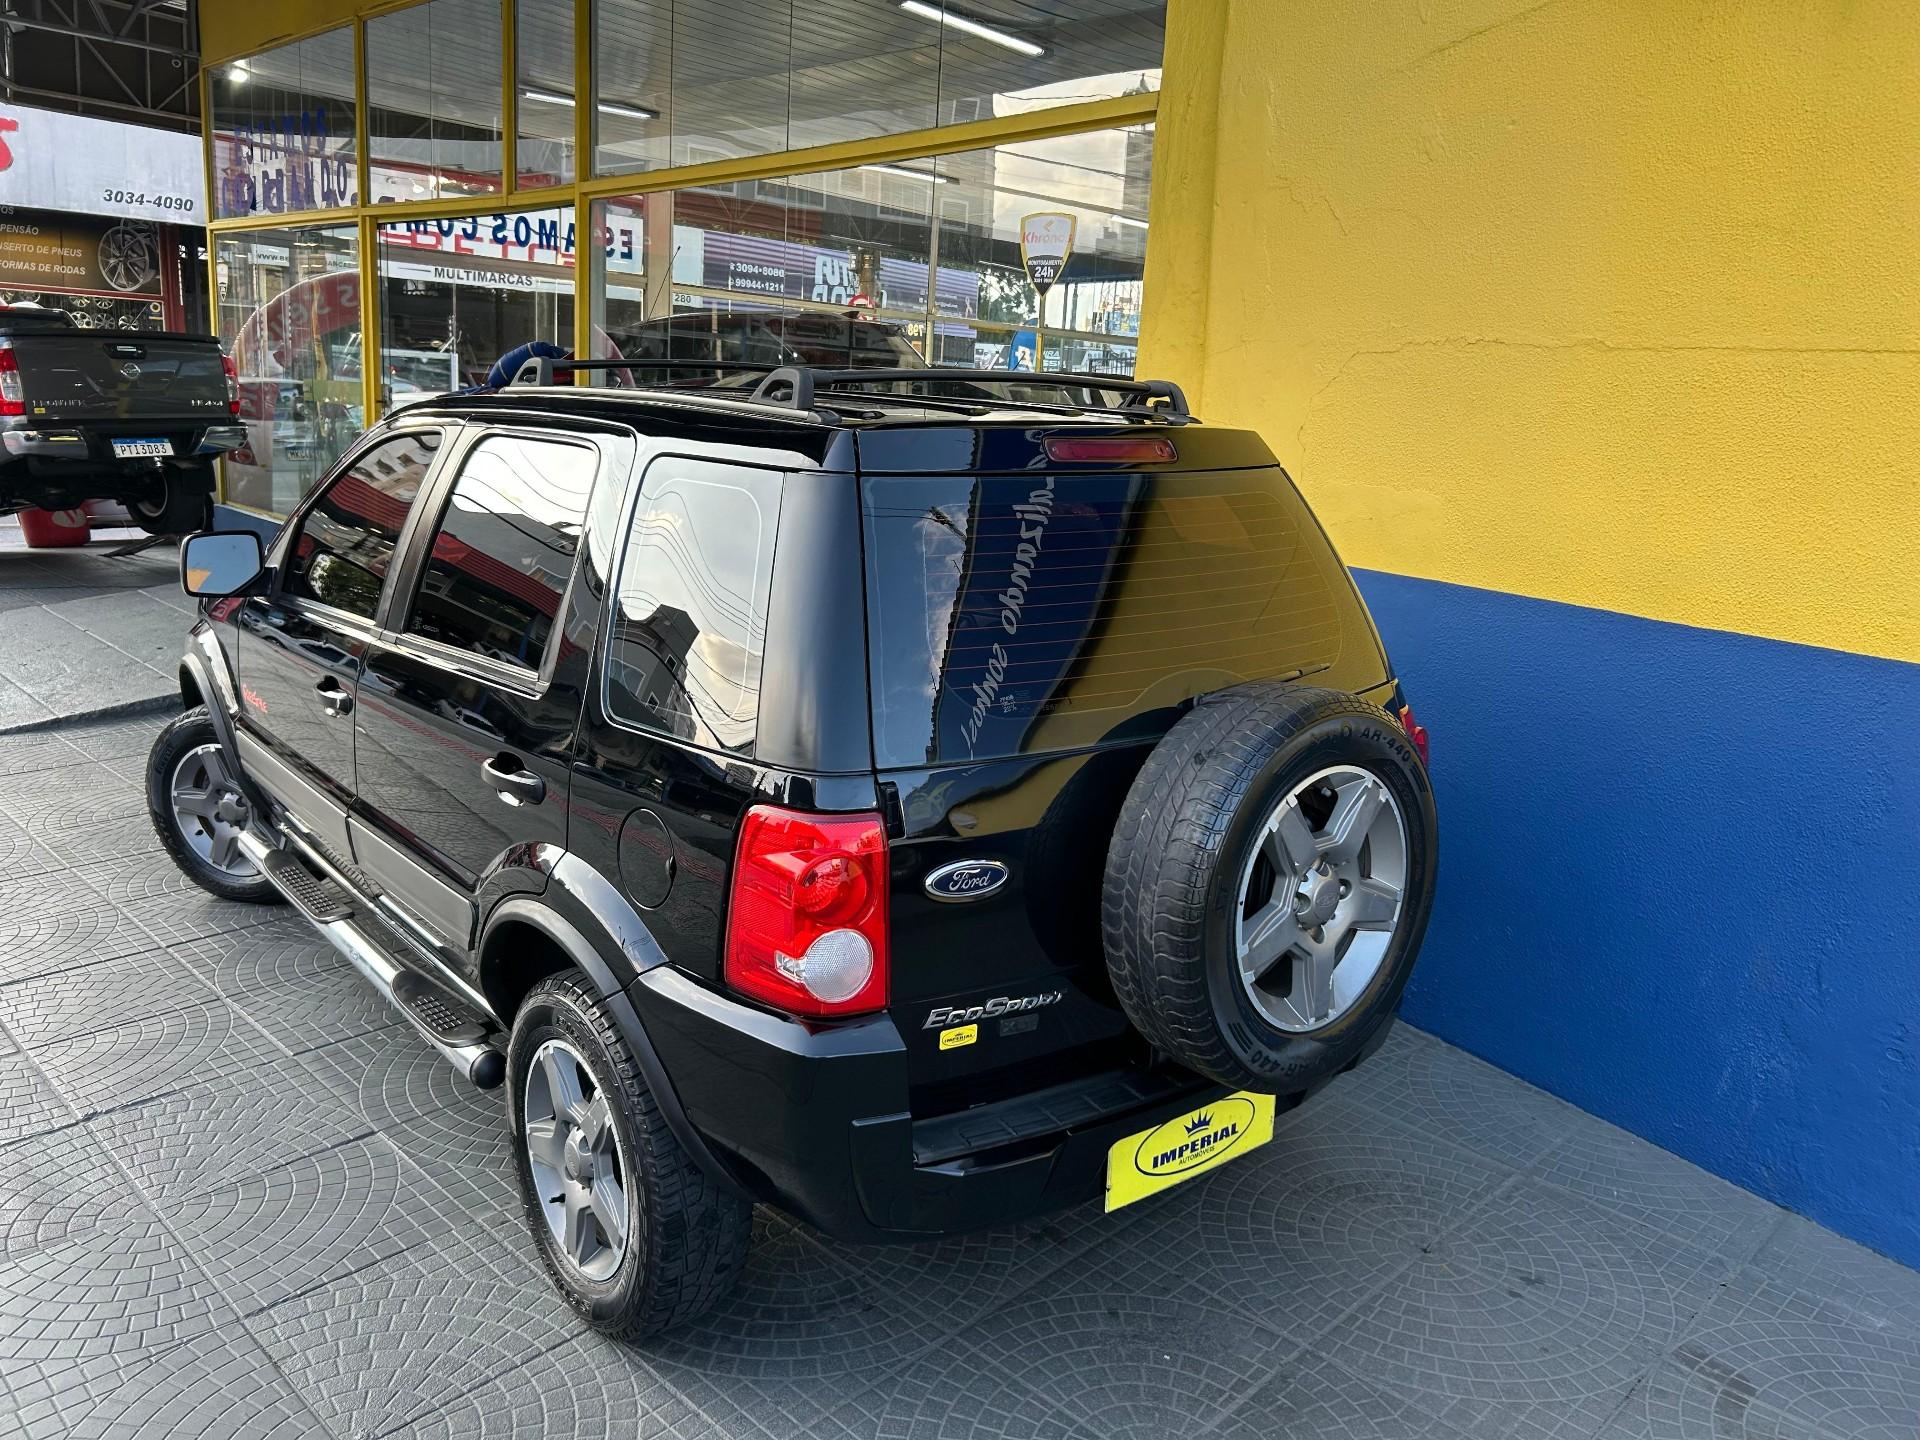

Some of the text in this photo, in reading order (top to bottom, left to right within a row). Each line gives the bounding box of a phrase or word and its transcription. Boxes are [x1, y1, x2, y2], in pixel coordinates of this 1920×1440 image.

[103, 188, 194, 212] 3034-4090
[36, 245, 49, 255] DE
[51, 246, 83, 258] PNEUS
[38, 263, 52, 273] DE
[53, 264, 87, 276] RODAS
[433, 266, 534, 288] MULTIMARCAS
[1034, 266, 1054, 278] 24h
[674, 294, 692, 304] 280
[948, 867, 991, 892] Ford
[1152, 1123, 1239, 1170] IMPERIAL
